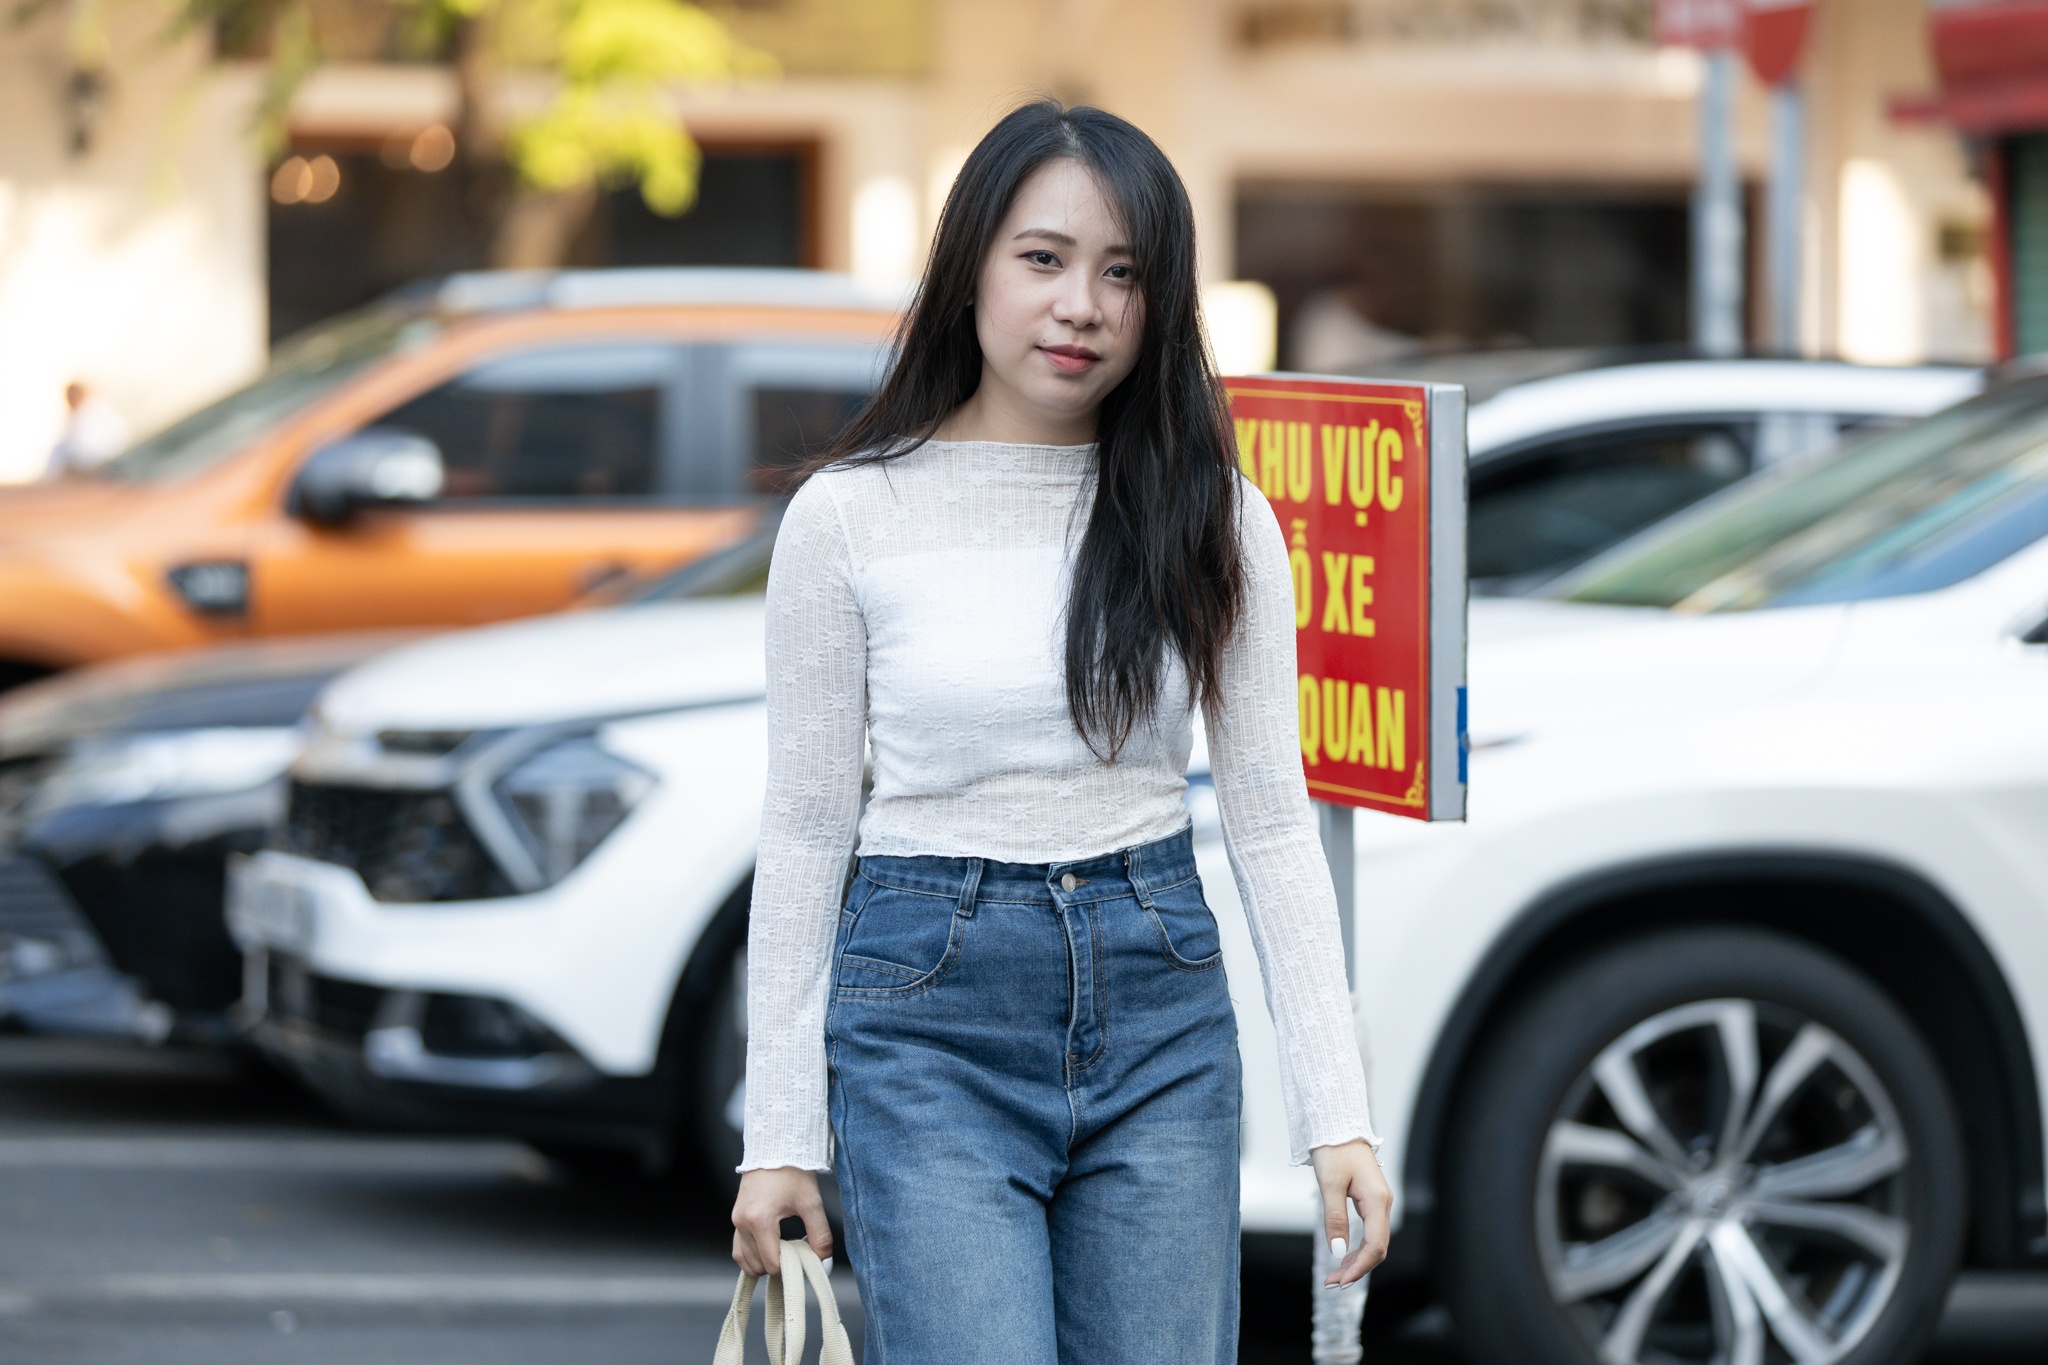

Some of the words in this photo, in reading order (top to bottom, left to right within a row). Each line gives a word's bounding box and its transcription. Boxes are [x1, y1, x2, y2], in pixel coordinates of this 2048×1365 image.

[1234, 418, 1312, 504] KHU
[1320, 418, 1403, 527] VỰC
[1321, 550, 1376, 638] XE
[1298, 672, 1405, 773] QUAN
